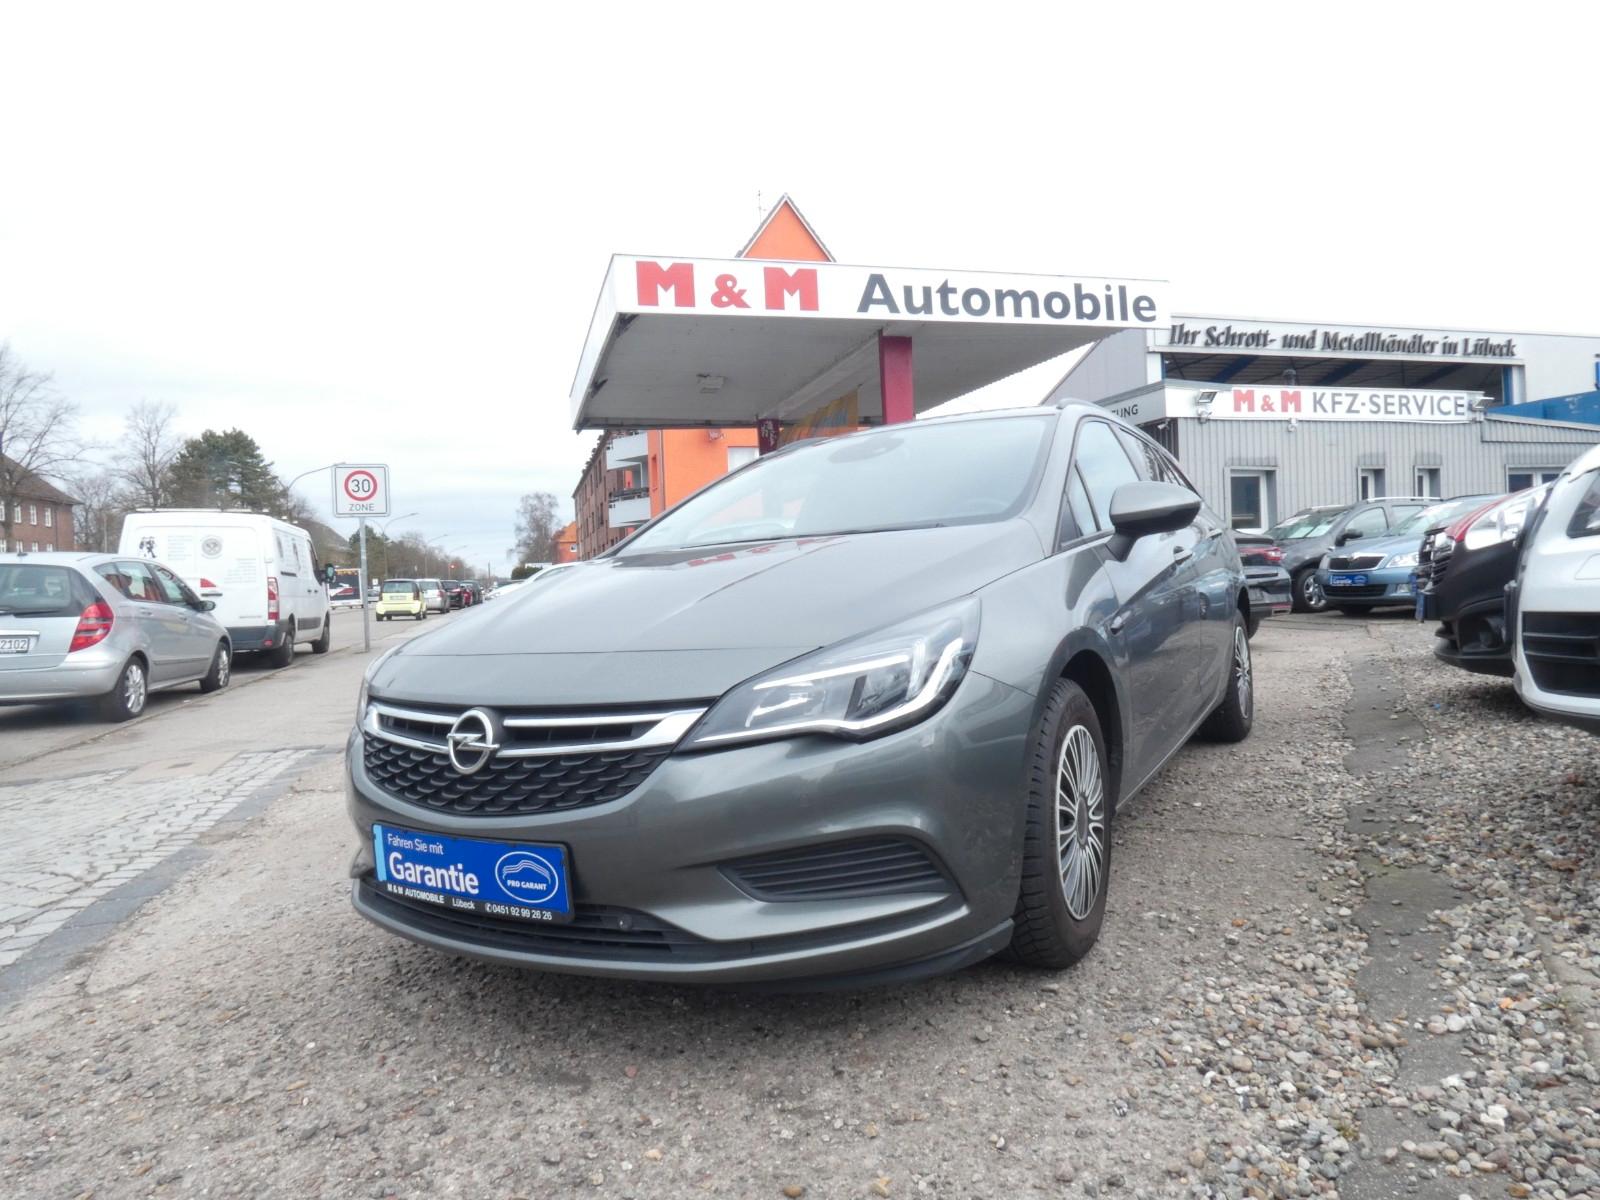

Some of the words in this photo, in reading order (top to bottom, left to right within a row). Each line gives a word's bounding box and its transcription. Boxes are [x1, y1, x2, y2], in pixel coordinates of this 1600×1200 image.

[636, 261, 696, 307] M
[711, 274, 752, 308] &
[764, 267, 819, 311] M
[857, 273, 1158, 322] Automobile
[1169, 323, 1201, 345] Ihr
[1204, 325, 1276, 348] Schrott-
[1282, 329, 1317, 349] und
[1321, 331, 1439, 354] Metallhändler
[1442, 336, 1459, 354] in
[1462, 337, 1516, 357] Lübeck
[1233, 389, 1255, 412] M
[1261, 395, 1276, 412] &
[1280, 391, 1301, 412] M
[351, 478, 371, 493] 30
[349, 503, 375, 511] ZONE
[387, 833, 414, 850] Fahren
[414, 838, 428, 852] Sie
[429, 842, 444, 855] mit
[389, 851, 480, 895] Garantie
[507, 879, 521, 888] PRO
[521, 881, 548, 891] GARANT
[404, 888, 445, 904] AUTOMOBILE
[452, 898, 476, 910] Lübeck
[511, 906, 521, 917] 92
[521, 908, 531, 918] 99
[542, 911, 553, 921] 26
